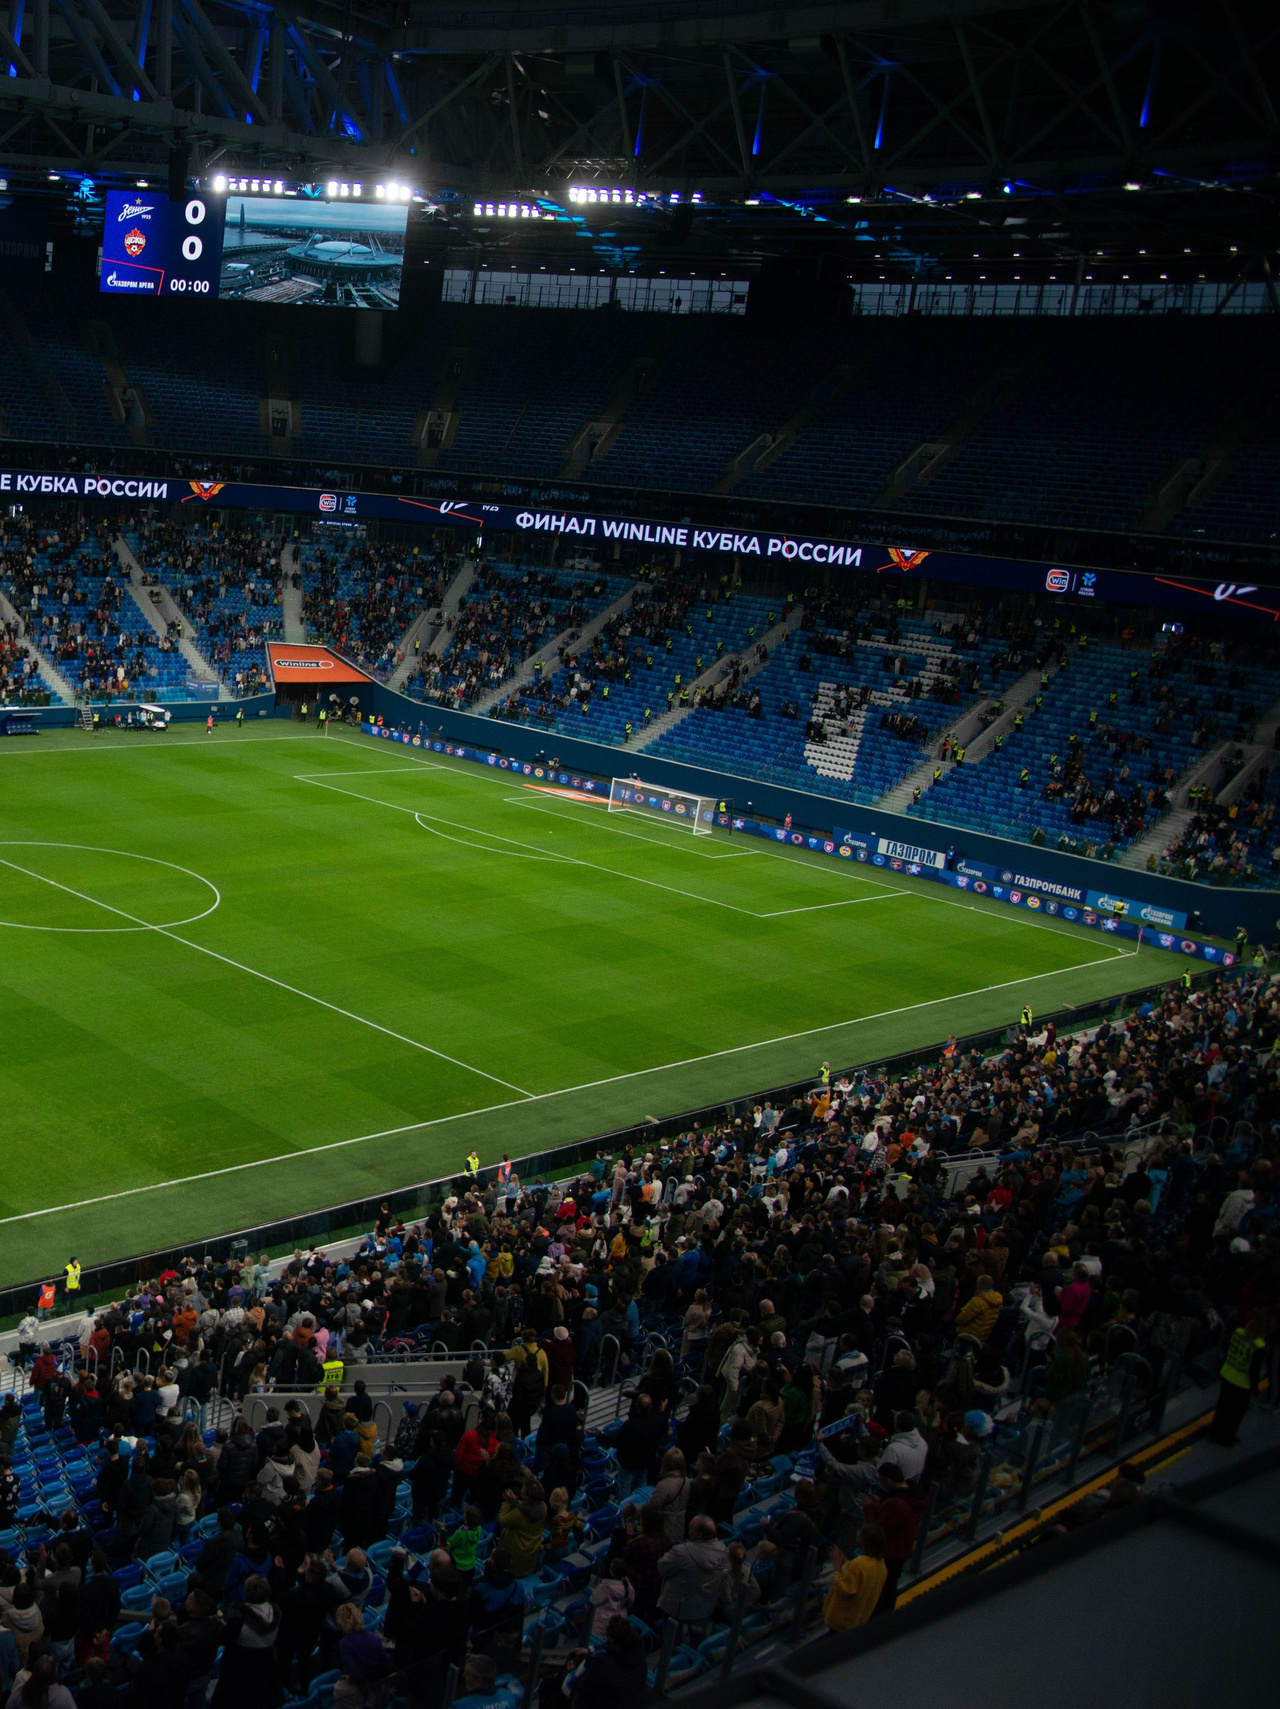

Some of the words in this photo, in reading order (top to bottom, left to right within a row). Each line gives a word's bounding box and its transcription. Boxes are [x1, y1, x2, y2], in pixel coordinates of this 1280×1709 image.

[185, 200, 206, 225] 0
[182, 235, 203, 261] 0
[114, 281, 138, 289] ГАЗПРОМ
[170, 279, 210, 293] 00:00
[16, 474, 79, 494] КУБКА
[84, 478, 168, 499] РОССИИ
[515, 511, 596, 536] ФИНАЛ
[602, 520, 688, 546] WINLINE
[693, 530, 761, 555] КУБКА
[767, 538, 862, 567] РОССИИ
[1051, 577, 1067, 585] Win
[848, 839, 867, 848] ГАЗПРОМ
[885, 840, 938, 866] ГАЗПРОМ
[962, 867, 983, 877] ГАЗПРОМ
[1014, 875, 1082, 900] ГАЗПРОМБАНК
